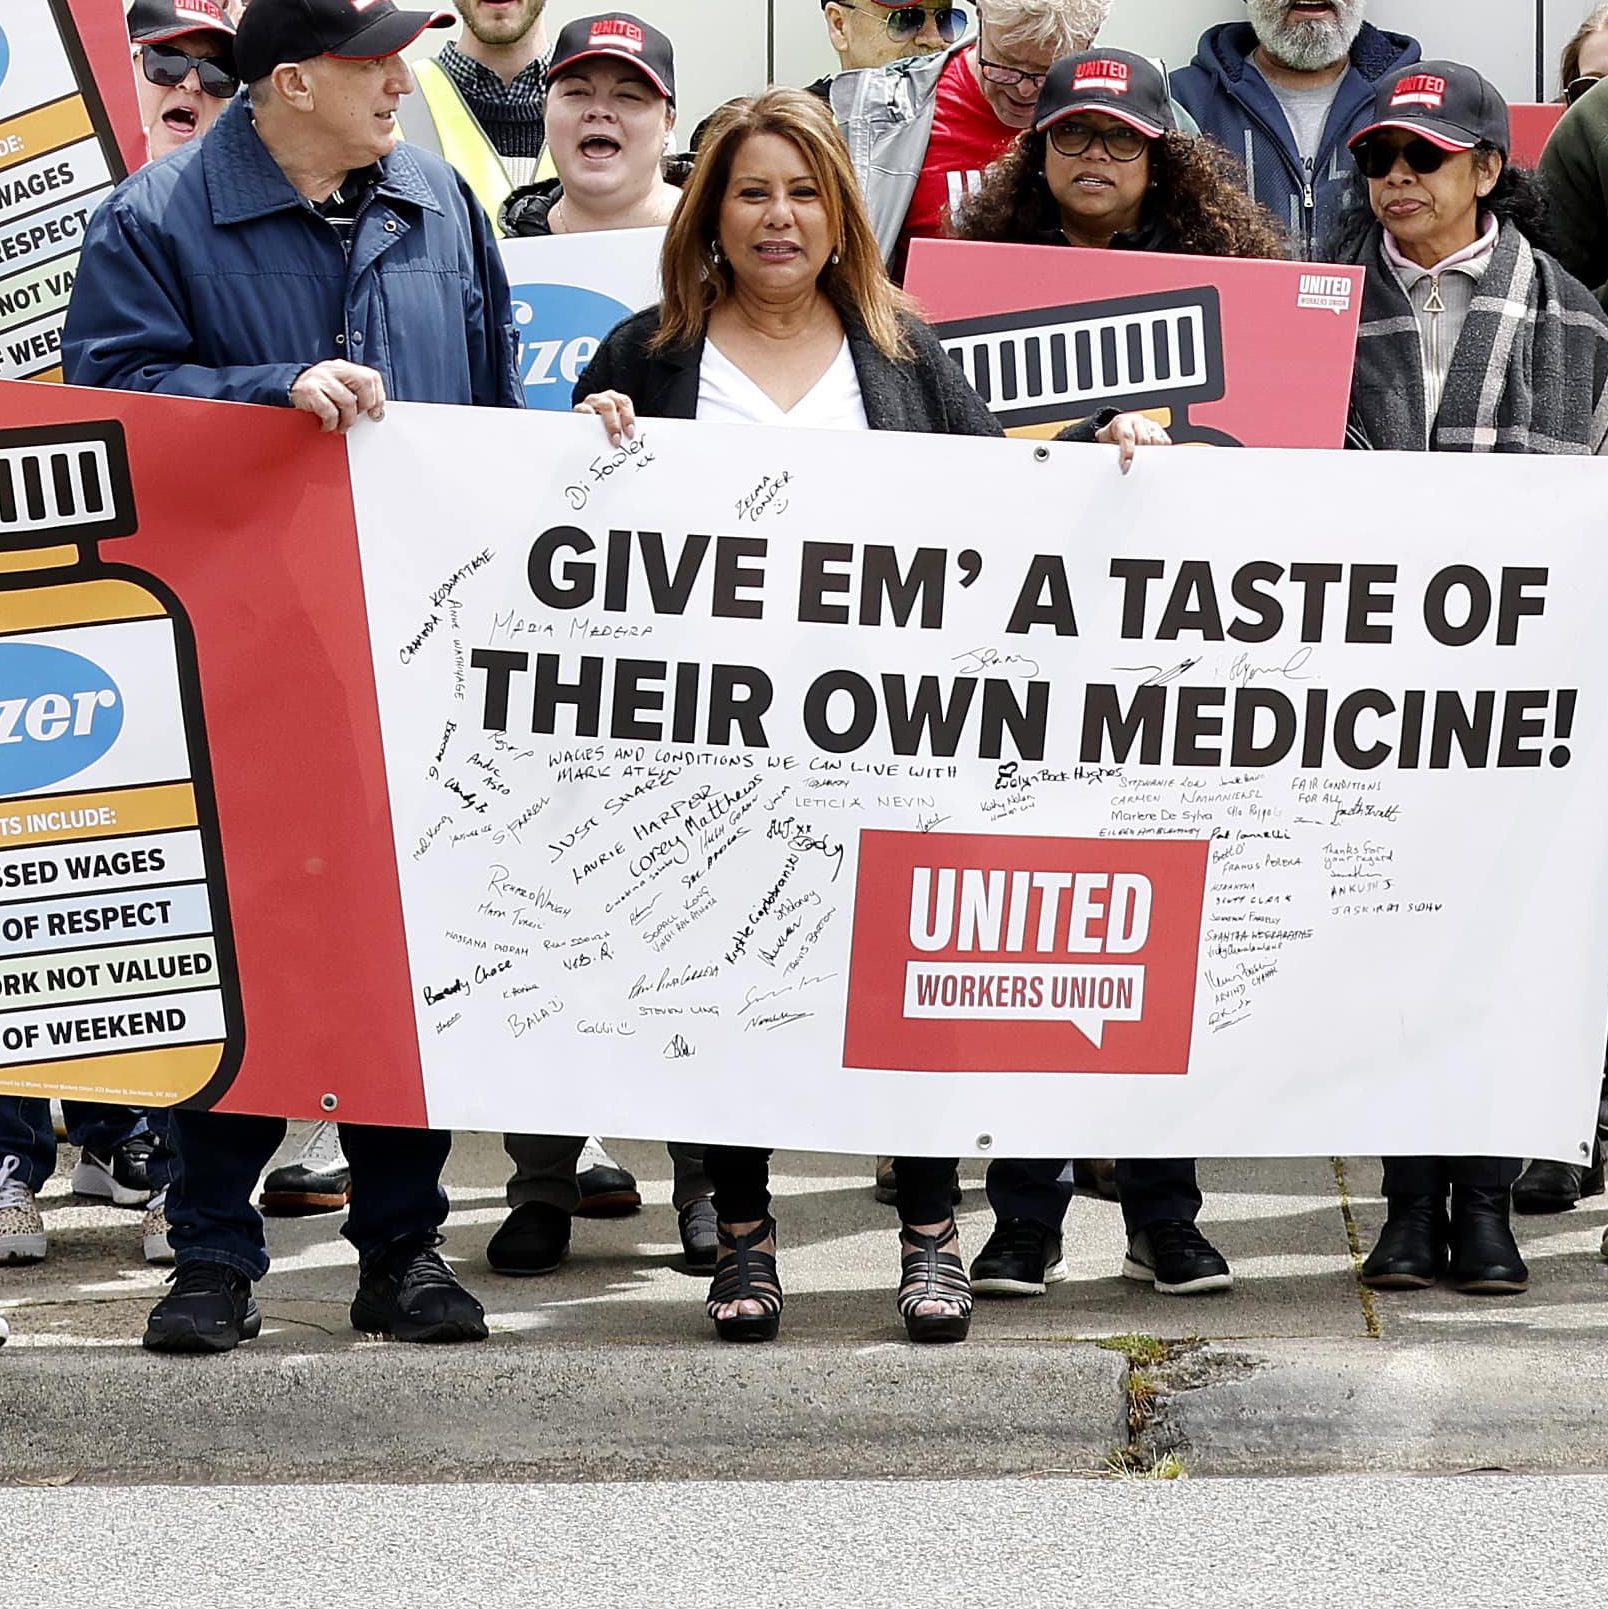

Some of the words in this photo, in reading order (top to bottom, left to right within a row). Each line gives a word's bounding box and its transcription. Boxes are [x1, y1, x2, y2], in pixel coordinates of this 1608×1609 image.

[592, 19, 642, 41] UNITED
[1076, 60, 1128, 79] UNITED
[1394, 74, 1445, 94] UNITED
[1299, 274, 1352, 296] UNITED
[565, 481, 590, 511] Di
[527, 525, 768, 619] GIVE
[1005, 554, 1078, 638] A
[1109, 558, 1397, 644] TASTE
[1423, 564, 1548, 646] OF
[471, 647, 773, 749] THEIR
[803, 668, 1050, 763] OWN
[1081, 683, 1578, 770] MEDICINE!
[549, 746, 605, 768] WAGES
[614, 746, 645, 762] AND
[655, 749, 754, 768] CONDITIONS
[768, 756, 800, 770] WE
[809, 757, 842, 770] CAN
[851, 761, 899, 776] LIVE
[909, 765, 957, 778] WITH
[557, 766, 611, 783] MARK
[1291, 778, 1319, 791] FAIR
[1323, 777, 1383, 791] CONDITIONS
[1298, 793, 1318, 803] FOR
[1322, 793, 1342, 804] ALL
[795, 796, 865, 810] LETICIA
[878, 795, 935, 808] NEVIN
[1111, 794, 1161, 806] CARMEN
[27, 807, 117, 833] INCLUDE:
[629, 835, 690, 878] Corey
[684, 774, 764, 837] Matthews
[1111, 810, 1157, 821] Marlene
[547, 816, 600, 864] JUST
[573, 843, 626, 884] LAURIE
[633, 784, 722, 841] HARPER
[65, 848, 166, 880] WAGES
[2, 916, 40, 941] OF
[47, 901, 171, 937] RESPECT
[909, 867, 1153, 954] UNITED
[47, 964, 101, 991] NOT
[107, 952, 213, 984] VALUED
[916, 974, 1044, 1009] WORKERS
[1051, 976, 1134, 1009] UNION
[507, 1008, 550, 1038] BALA
[639, 1006, 683, 1017] STEVEN
[2, 1024, 40, 1050] OF
[47, 1008, 186, 1045] WEEKEND
